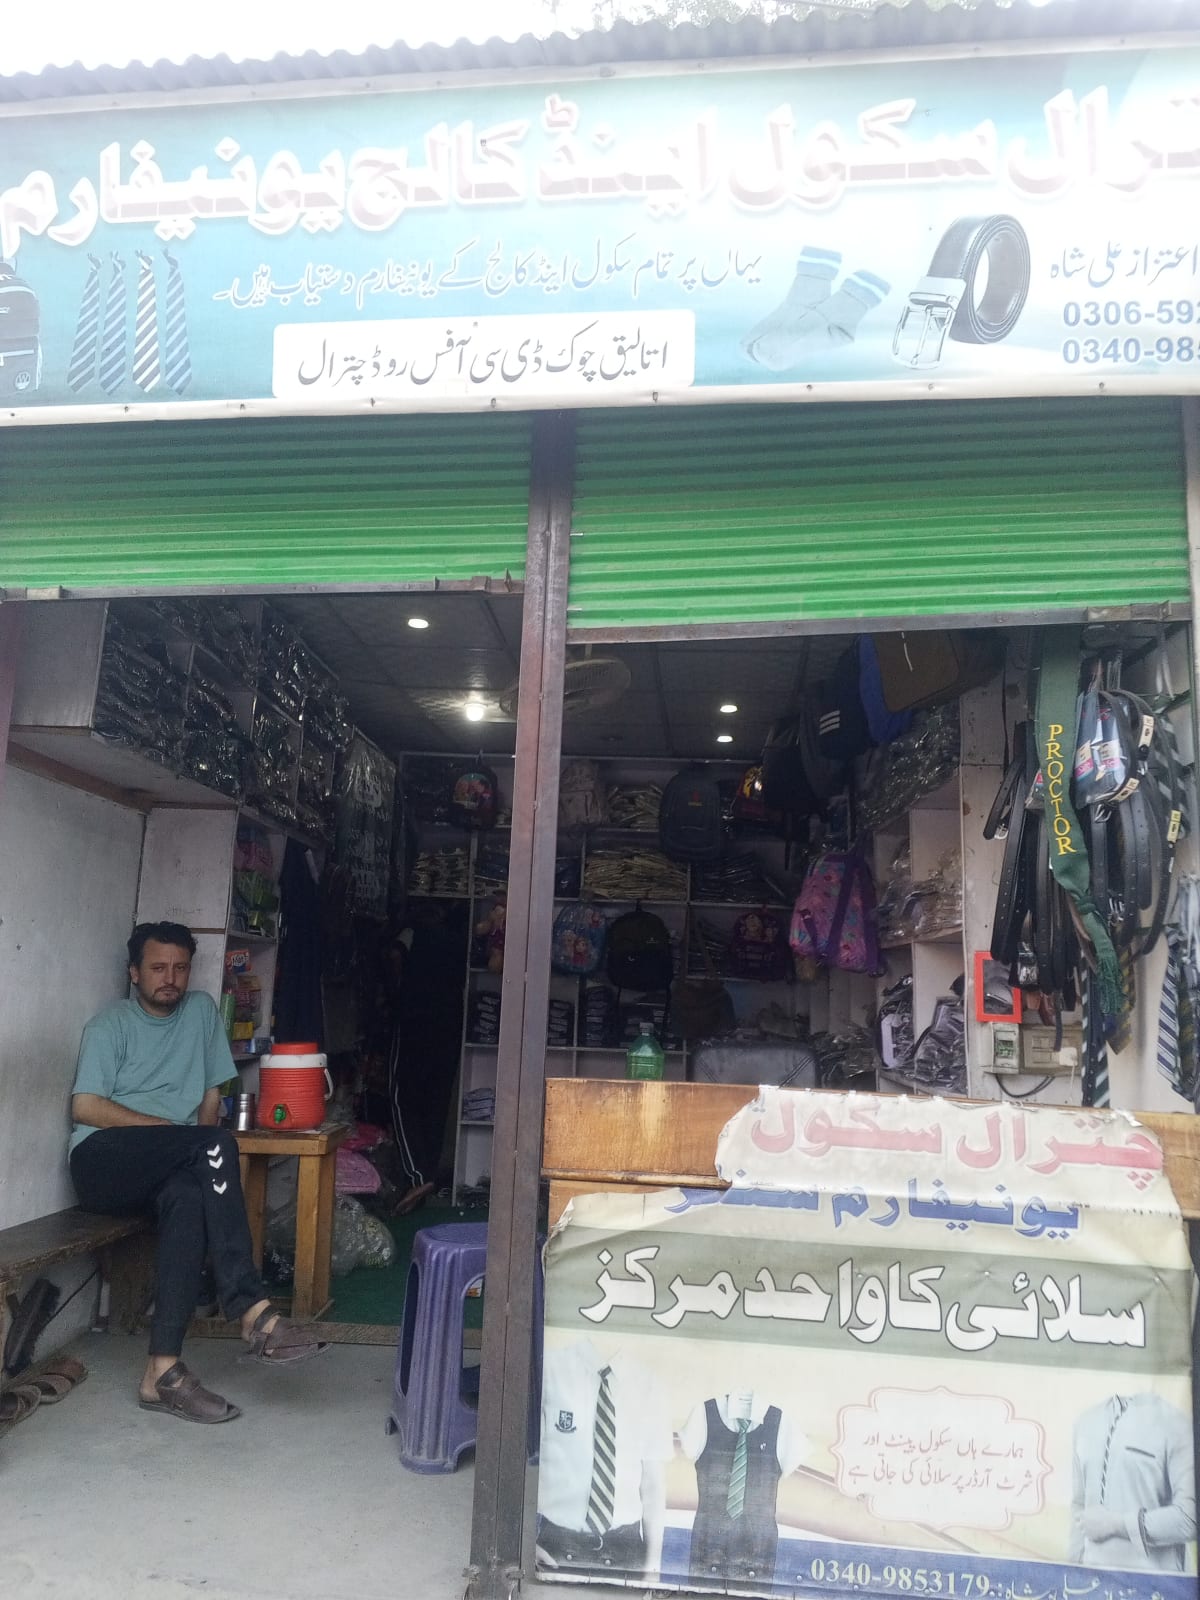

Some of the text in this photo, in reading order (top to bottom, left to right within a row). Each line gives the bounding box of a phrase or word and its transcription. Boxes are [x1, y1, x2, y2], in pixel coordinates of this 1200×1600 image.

[0, 84, 1200, 258] ترال سکول اینڈ کالج یونیفارم
[270, 262, 353, 305] دستیاب
[357, 258, 436, 309] یونیفارم
[437, 239, 484, 289] کے
[485, 240, 536, 297] کالج
[533, 254, 568, 292] اینڈ
[571, 231, 637, 289] سکول
[632, 250, 675, 297] تمام
[677, 256, 697, 291] پر
[700, 248, 763, 288] یہاں
[1050, 246, 1087, 279] شاہ
[1087, 240, 1123, 288] علی
[1062, 300, 1200, 327] 0306-59
[298, 338, 367, 388] چترال
[409, 327, 472, 386] آفس
[545, 319, 599, 383] چوک
[599, 325, 669, 382] اتالیق
[1045, 724, 1078, 856] PROCTOR
[750, 1097, 1165, 1192] چترال سکول
[833, 1176, 1080, 1241] یونیفارم
[579, 1246, 740, 1328] مرکز
[889, 1261, 945, 1333] کا
[945, 1271, 1146, 1352] سلائی
[864, 1431, 880, 1446] اور
[919, 1426, 952, 1454] سکول
[848, 1465, 869, 1485] ہے
[810, 1558, 990, 1598] 0340-9853179
